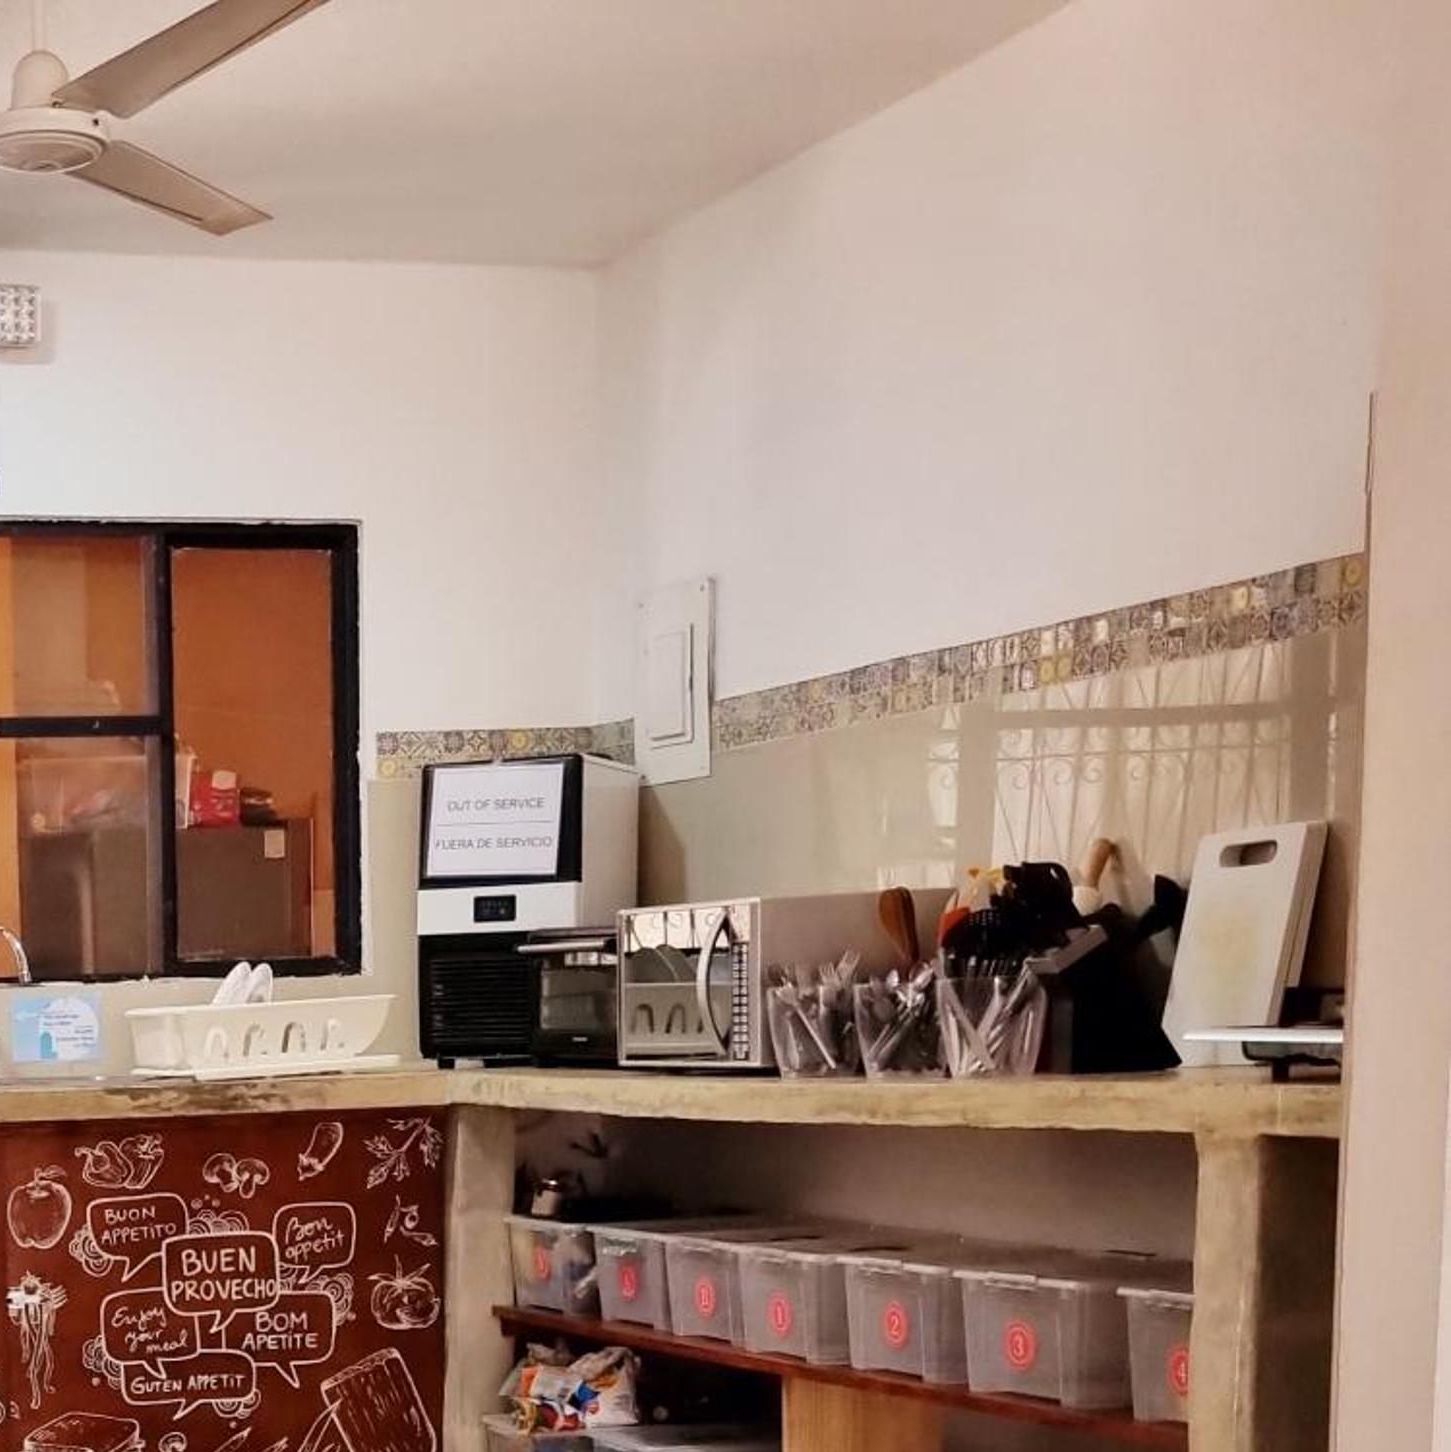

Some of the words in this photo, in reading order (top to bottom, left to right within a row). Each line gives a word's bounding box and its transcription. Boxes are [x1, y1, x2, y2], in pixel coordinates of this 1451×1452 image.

[448, 800, 471, 812] OUT
[475, 799, 491, 812] OF
[494, 797, 545, 811] SERVICE
[436, 838, 474, 850] FUERA
[477, 837, 493, 850] DE
[496, 836, 553, 849] SERVICIO
[104, 1205, 156, 1225] BUON
[285, 1216, 334, 1245] Bon
[285, 1229, 345, 1264] appetit
[181, 1245, 256, 1277] BUEN
[171, 1278, 276, 1303] PROVECHO
[111, 1306, 167, 1332] Enjoy
[255, 1311, 309, 1333] BOM
[125, 1329, 164, 1353] your
[146, 1328, 188, 1354] meal
[130, 1375, 183, 1395] GUTEN
